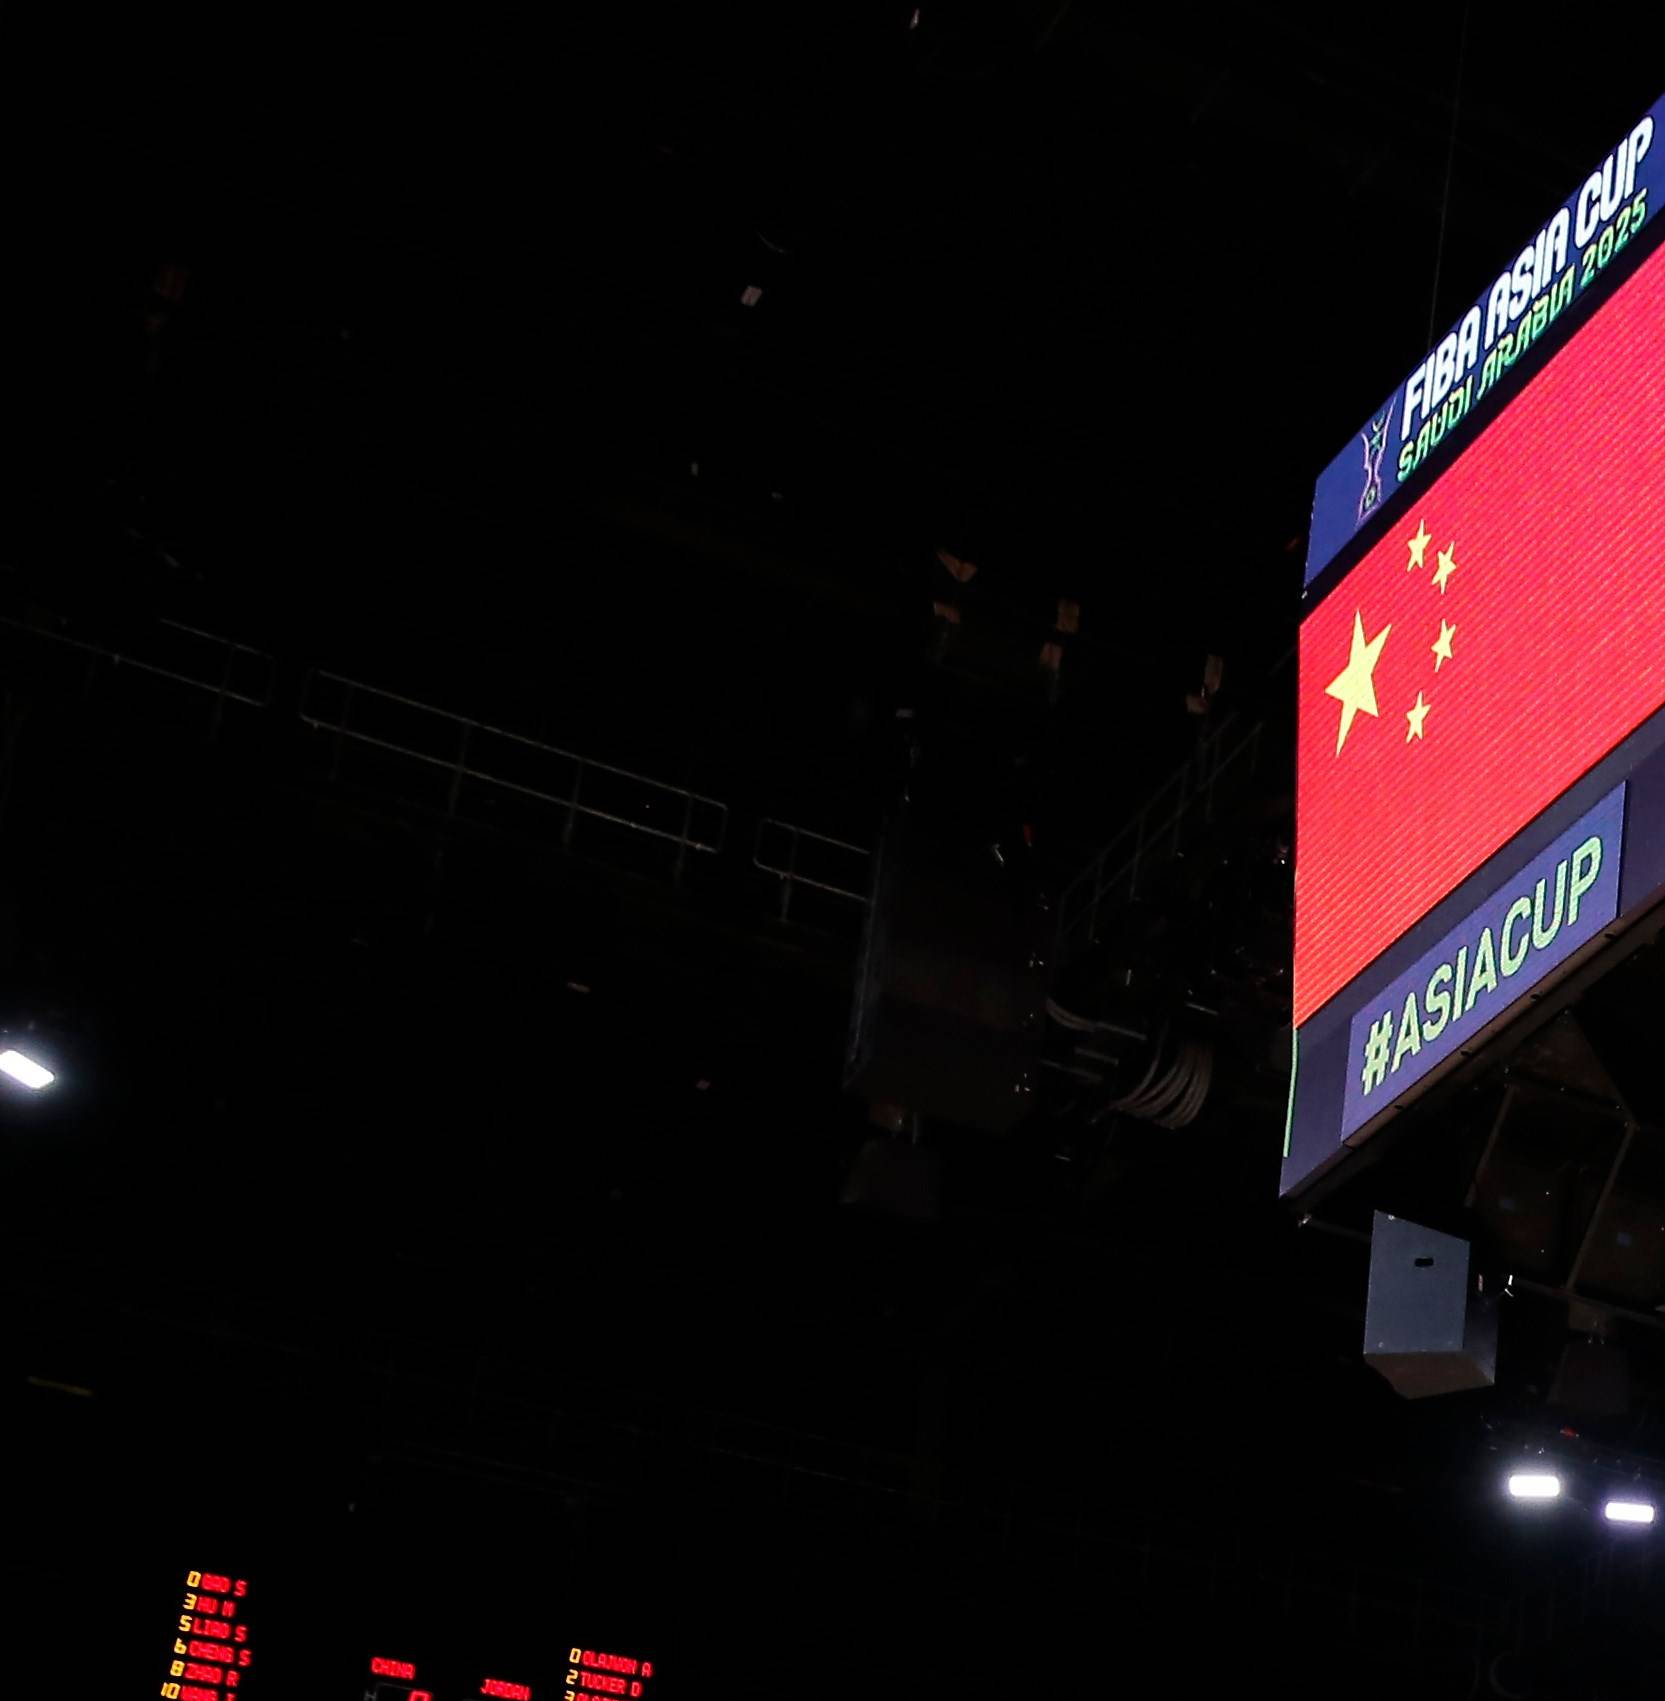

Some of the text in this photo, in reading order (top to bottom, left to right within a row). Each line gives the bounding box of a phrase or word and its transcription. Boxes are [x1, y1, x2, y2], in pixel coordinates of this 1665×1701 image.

[1401, 115, 1654, 441] FIBA ASIA CUP
[1396, 187, 1647, 482] SAUDI ARABIA 2025
[1361, 835, 1604, 1096] #ASIACUP
[187, 1571, 201, 1587] 0
[183, 1593, 197, 1610] 3
[178, 1615, 192, 1631] 5
[174, 1638, 187, 1654] 6
[170, 1660, 185, 1676] 8
[371, 1656, 416, 1680] CHINA
[570, 1648, 581, 1664] 0
[642, 1661, 653, 1678] A
[161, 1682, 180, 1699] 10
[480, 1678, 531, 1701] JORDAN
[566, 1669, 578, 1685] 2
[580, 1671, 627, 1695] TUCKER
